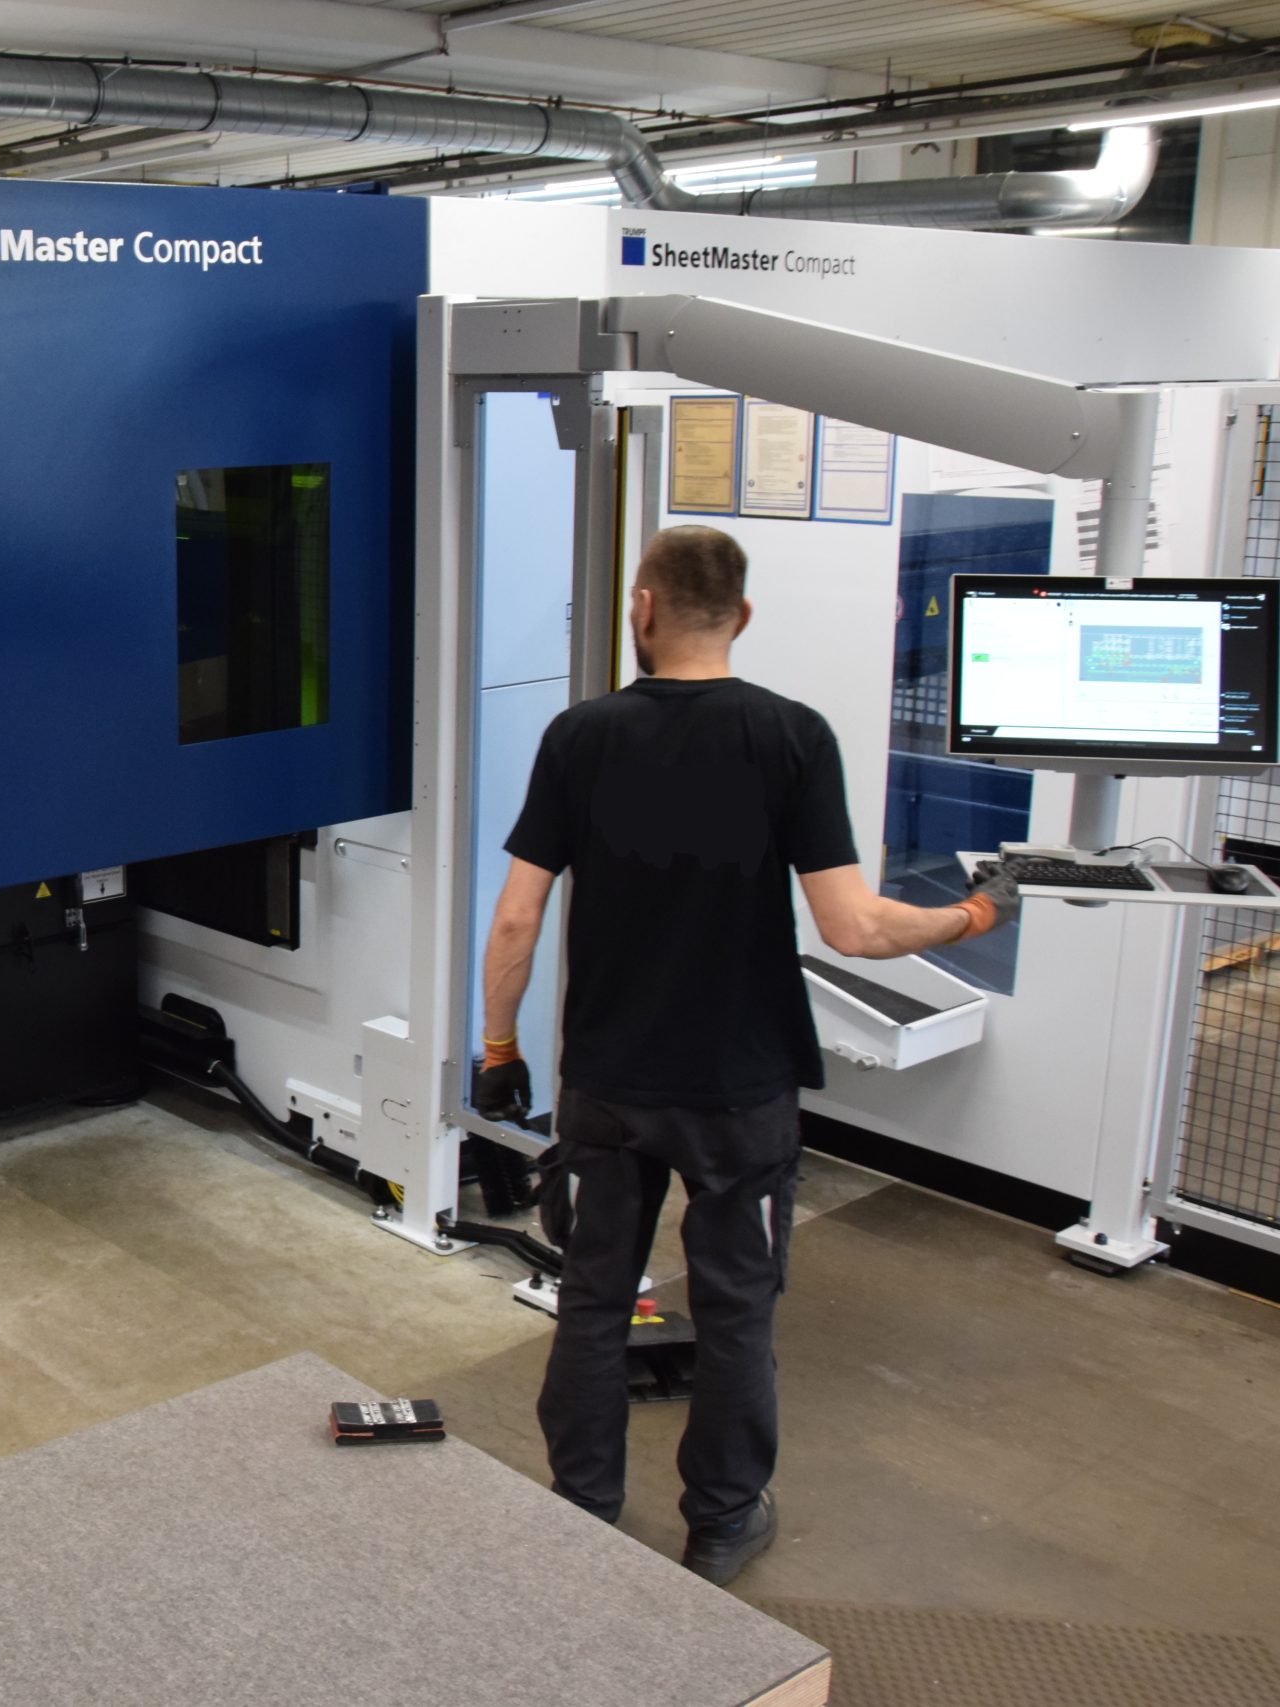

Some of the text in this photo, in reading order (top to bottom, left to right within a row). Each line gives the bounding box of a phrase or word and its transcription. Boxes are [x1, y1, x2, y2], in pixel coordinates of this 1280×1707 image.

[133, 231, 263, 272] Compact
[652, 243, 856, 280] SheetMaster Compact
